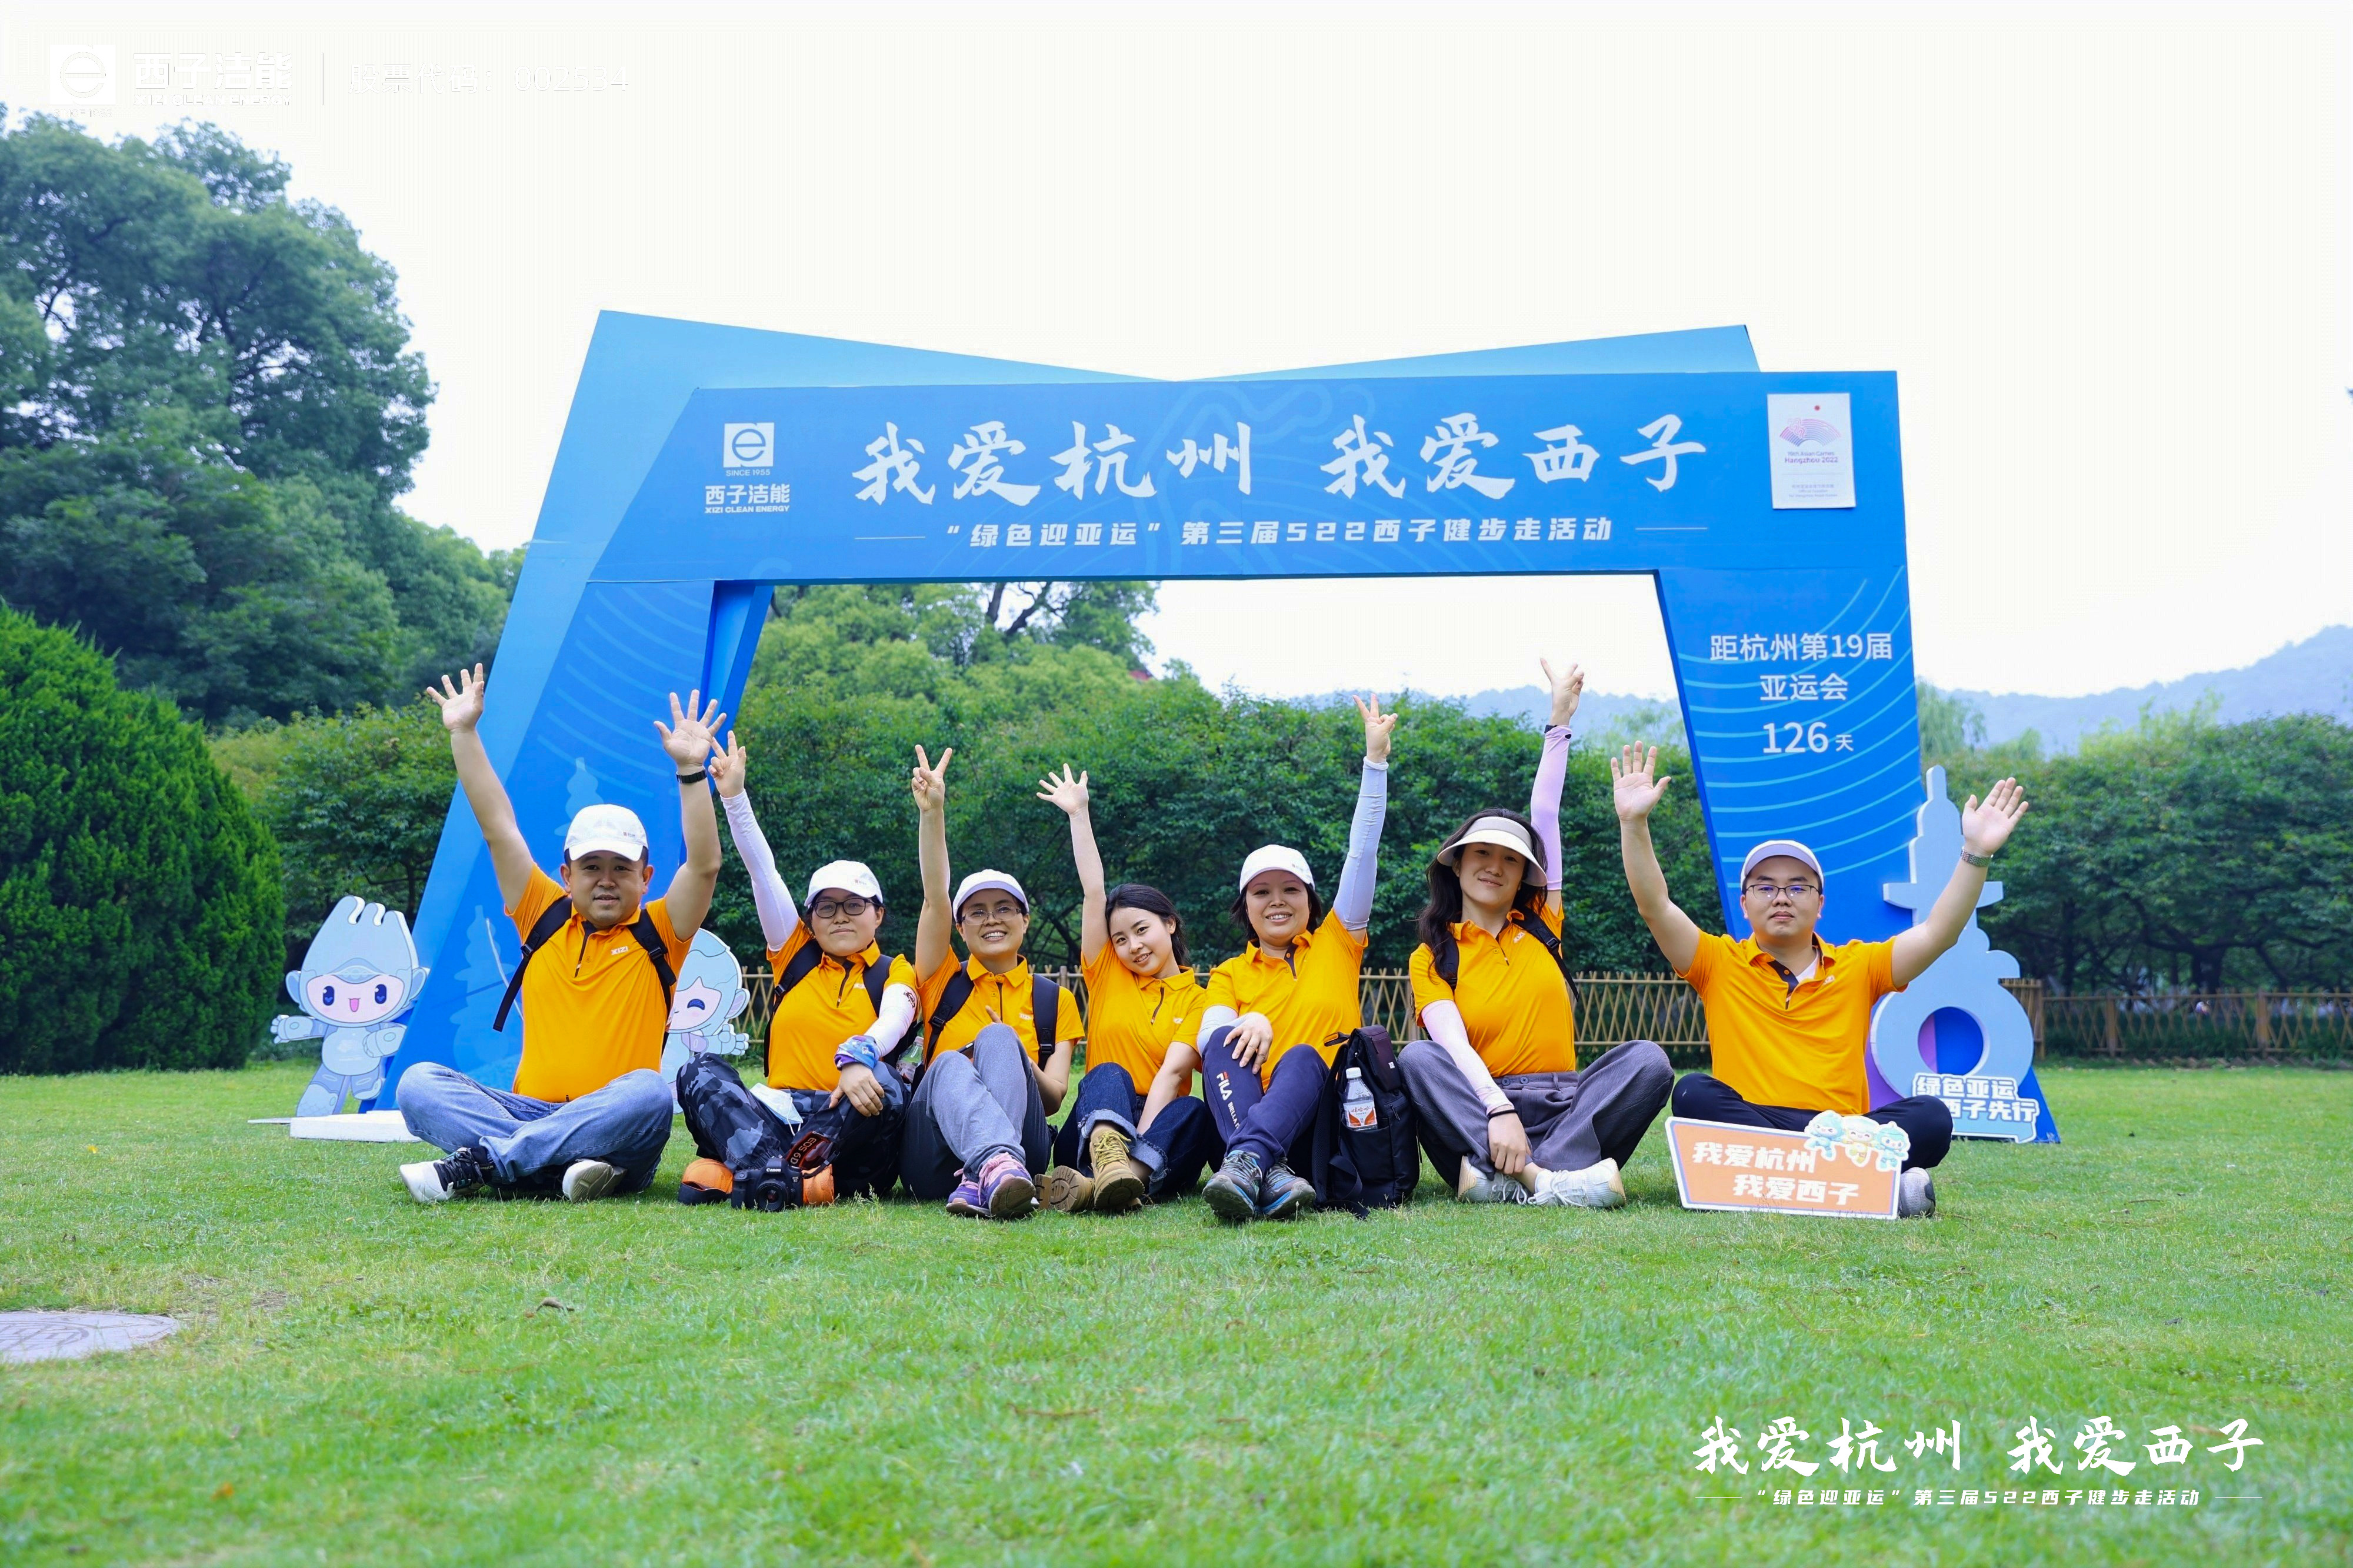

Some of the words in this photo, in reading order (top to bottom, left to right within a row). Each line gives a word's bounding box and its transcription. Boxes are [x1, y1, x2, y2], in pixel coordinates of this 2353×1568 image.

[852, 421, 1251, 506] 我爱杭州
[1321, 413, 1706, 500] 我爱西子
[705, 483, 791, 505] 西子洁能
[1710, 633, 1892, 661] 距杭州第19届
[1760, 672, 1848, 700] 亚运会
[1217, 1071, 1232, 1100] FILA
[1228, 1102, 1238, 1125] BIELLA
[1917, 1076, 2015, 1100] 绿色亚运
[790, 1152, 801, 1165] 6D
[798, 1137, 817, 1152] EOS
[1692, 1141, 1816, 1173] 我爱杭州
[1732, 1174, 1860, 1205] 我爱西子
